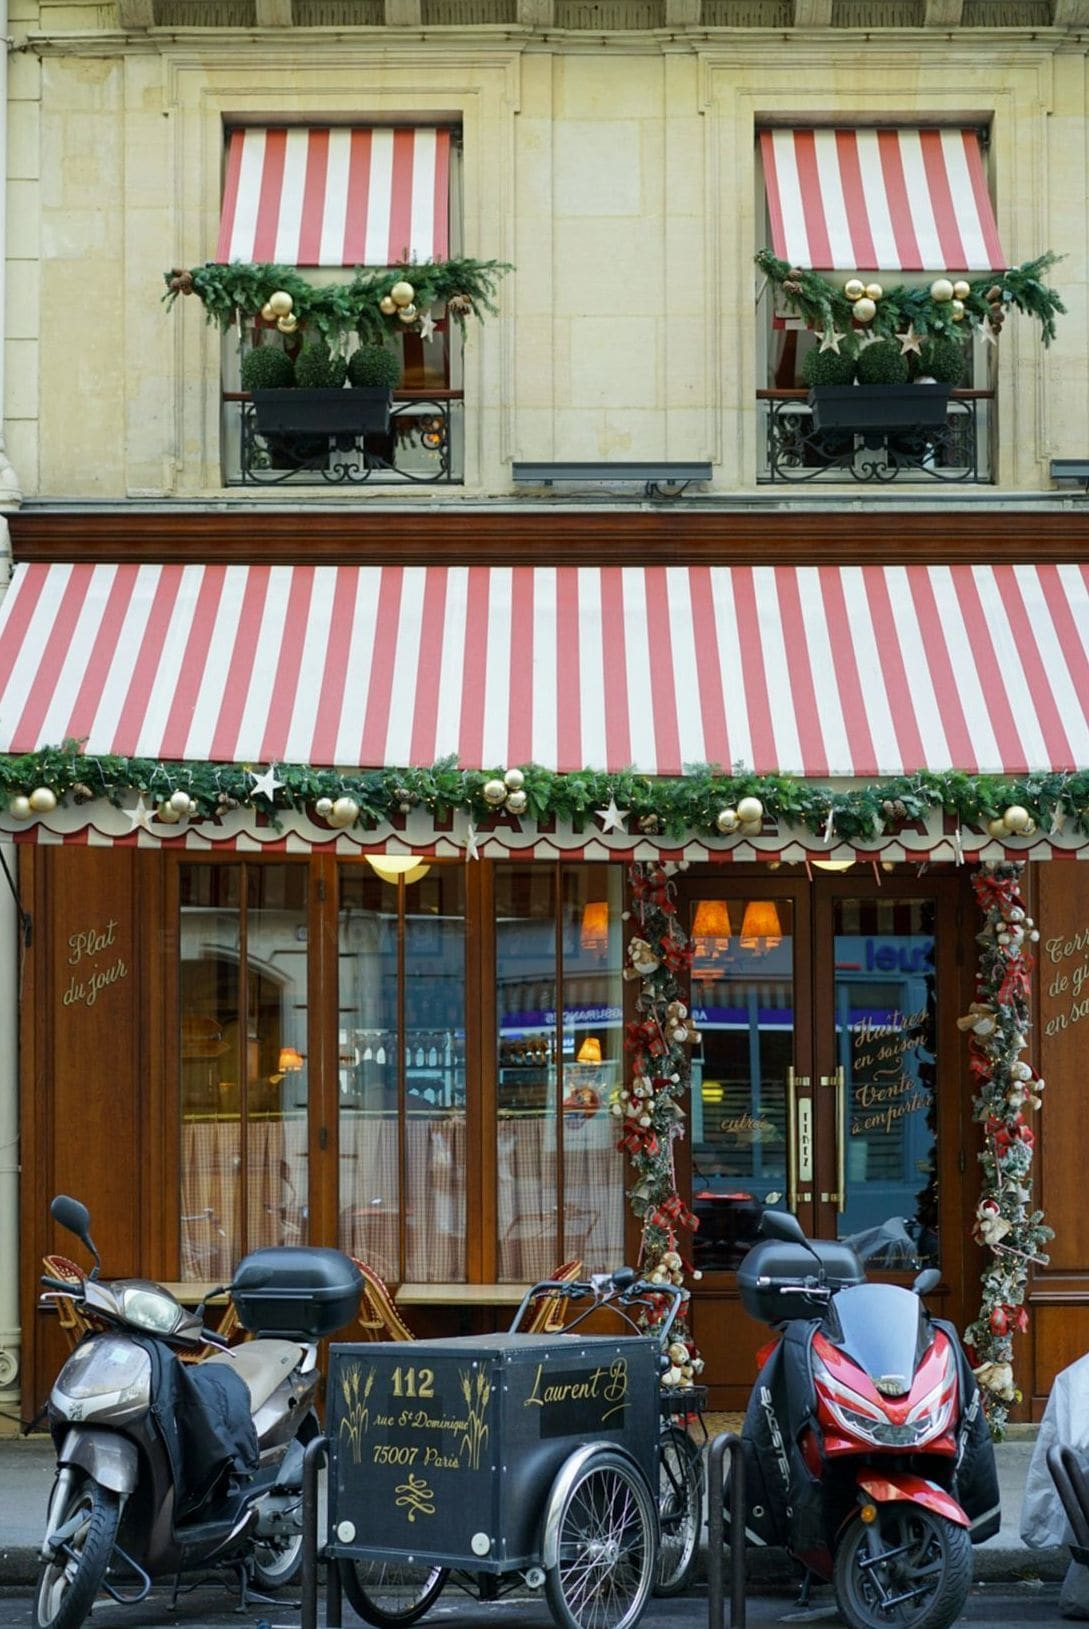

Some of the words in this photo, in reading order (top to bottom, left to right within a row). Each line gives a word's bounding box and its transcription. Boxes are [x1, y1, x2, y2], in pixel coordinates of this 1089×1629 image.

[68, 919, 118, 965] Plat
[63, 976, 86, 1005] du
[86, 958, 127, 1006] jour
[1048, 972, 1068, 997] de
[1044, 1014, 1067, 1036] en
[853, 1053, 874, 1070] en
[876, 1034, 929, 1061] saison
[855, 1072, 915, 1107] Vente
[391, 1366, 435, 1398] 112
[523, 1363, 608, 1406] Laurent
[604, 1356, 630, 1402] B
[373, 1413, 395, 1427] rue
[411, 1410, 469, 1438] Dominique
[373, 1445, 418, 1466] 75007
[423, 1446, 460, 1469] Paris
